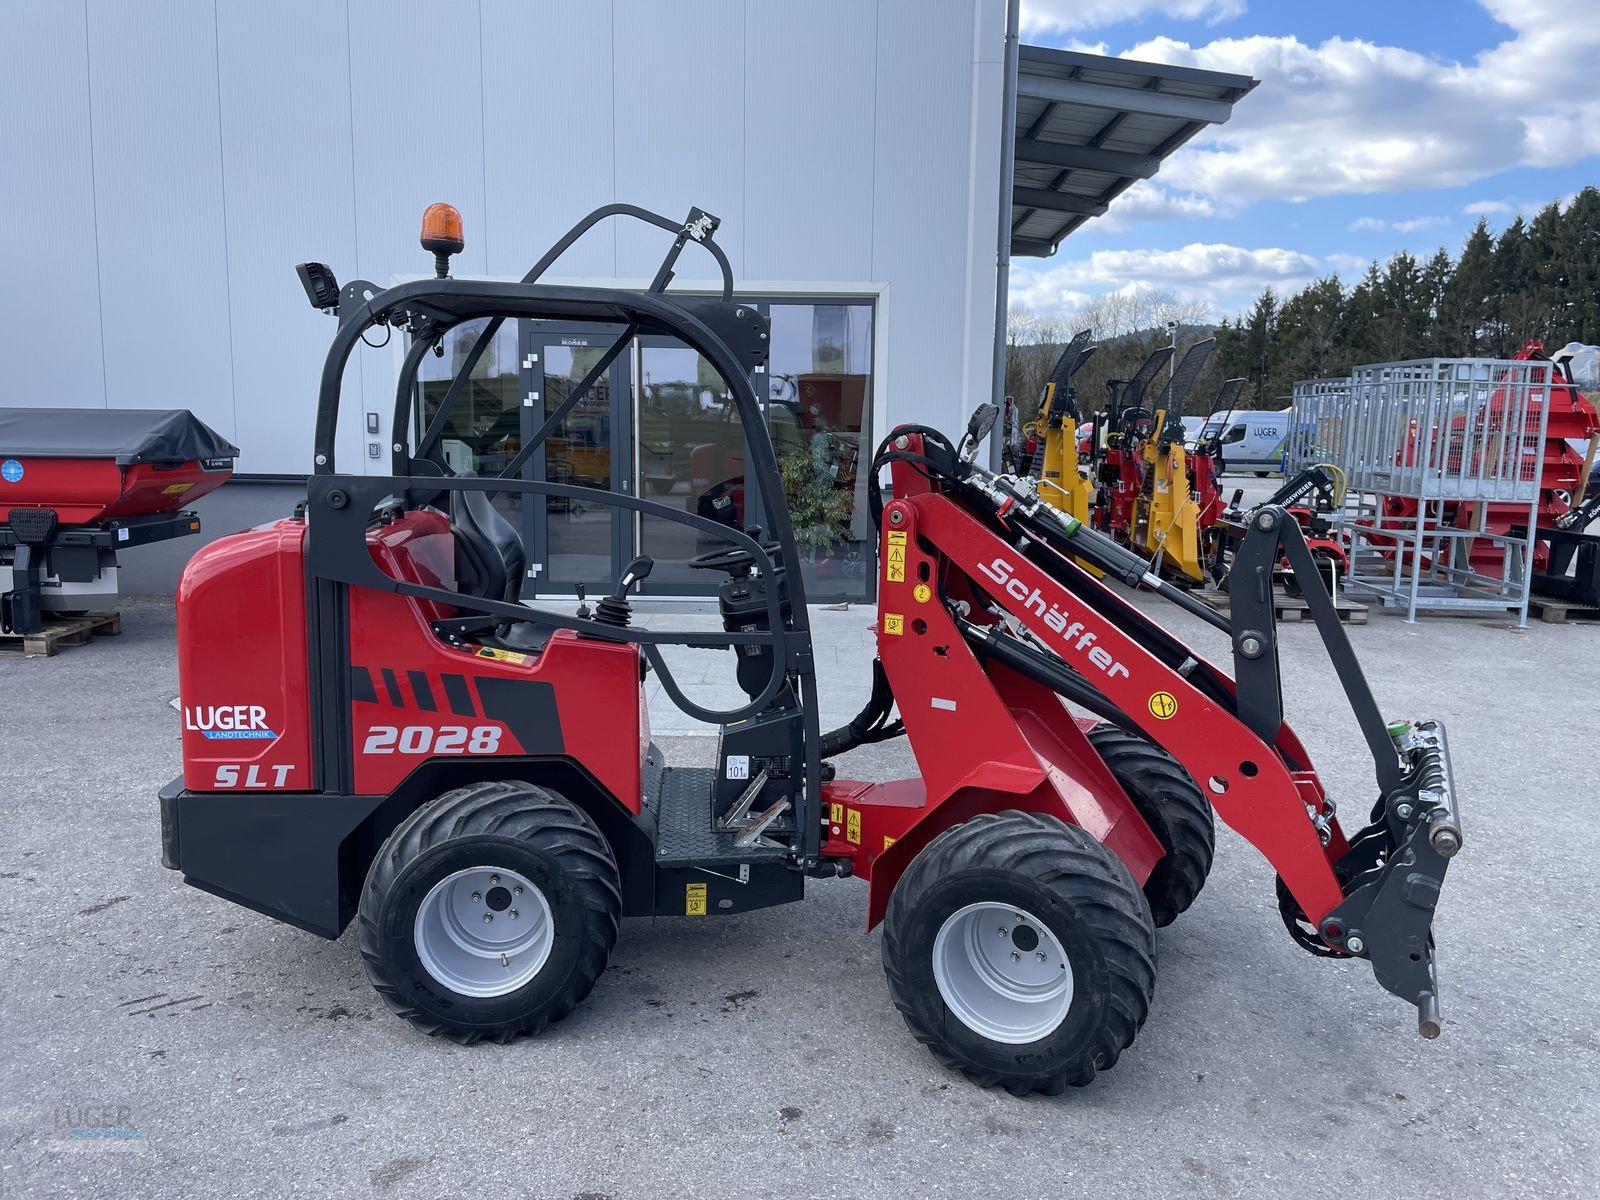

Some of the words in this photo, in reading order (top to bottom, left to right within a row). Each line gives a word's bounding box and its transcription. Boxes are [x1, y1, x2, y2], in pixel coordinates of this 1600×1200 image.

[1254, 427, 1277, 436] LUGER
[976, 558, 1130, 679] Schäffer
[185, 705, 270, 731] LUGER
[209, 731, 272, 739] LANDTECHNIK
[362, 725, 503, 754] 2028
[213, 764, 296, 788] SLT
[729, 766, 743, 777] 101
